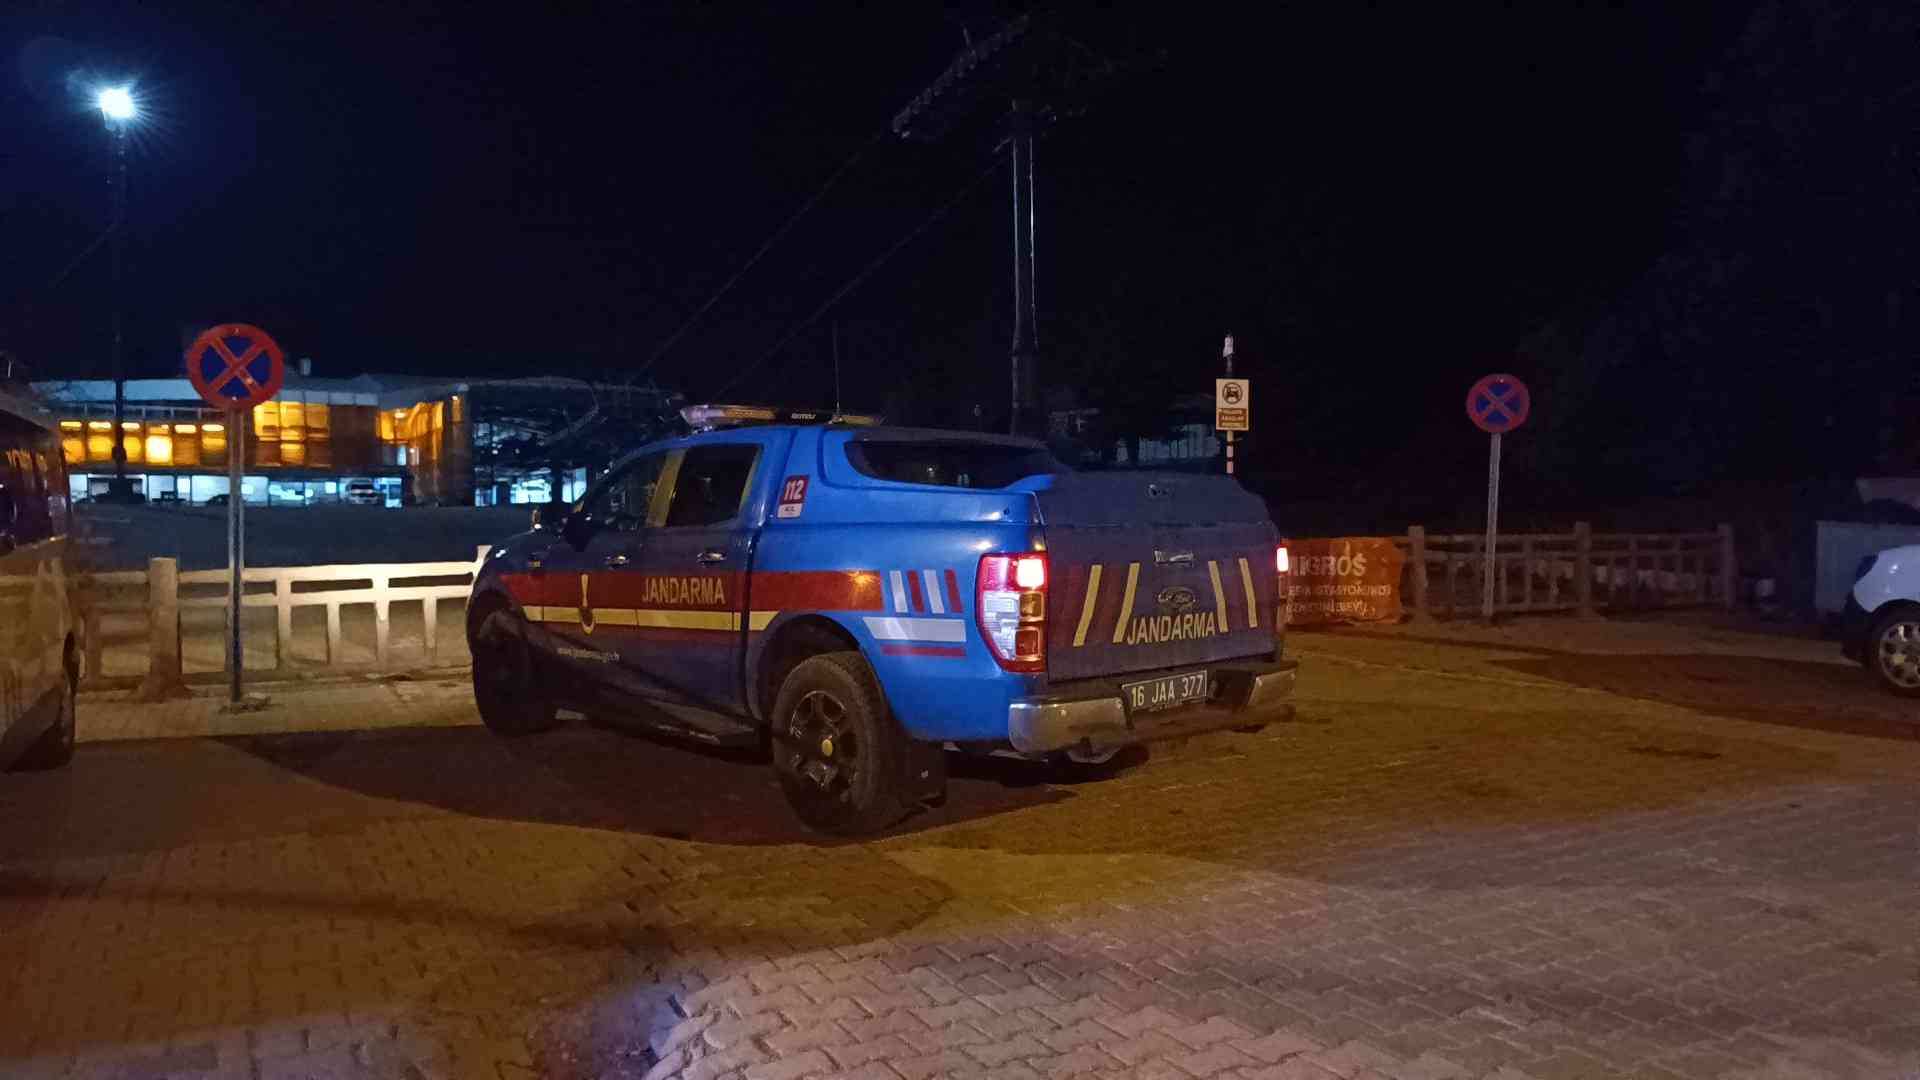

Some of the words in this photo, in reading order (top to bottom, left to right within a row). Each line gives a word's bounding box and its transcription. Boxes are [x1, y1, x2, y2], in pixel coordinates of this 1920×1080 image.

[785, 480, 804, 501] 112
[643, 577, 725, 605] JANDARMA
[1127, 612, 1216, 645] JANDARMA
[1131, 686, 1145, 708] 16
[1152, 680, 1176, 704] JAA
[1181, 675, 1204, 698] 377
